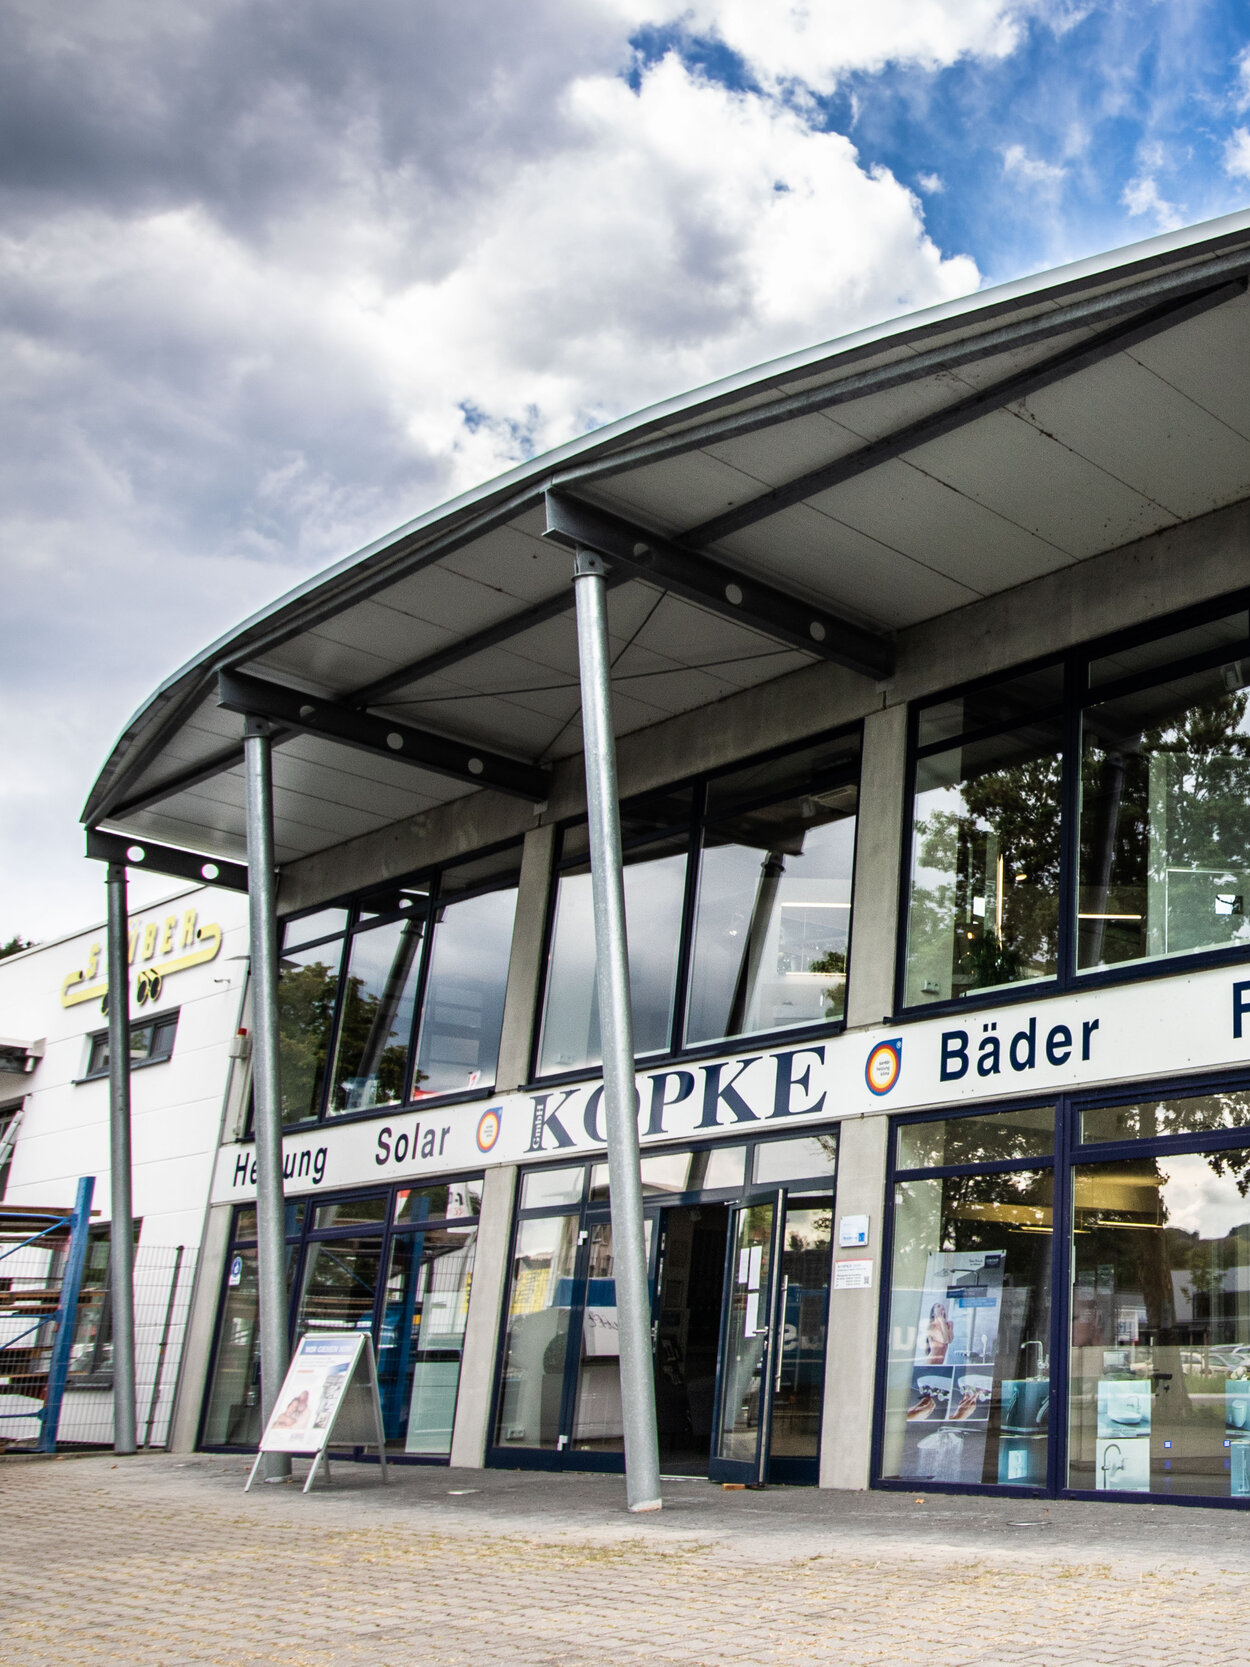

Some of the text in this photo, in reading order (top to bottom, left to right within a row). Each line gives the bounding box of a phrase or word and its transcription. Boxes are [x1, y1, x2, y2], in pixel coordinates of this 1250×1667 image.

[84, 908, 196, 979] SÜBER
[939, 1017, 1099, 1082] Bäder
[233, 1122, 451, 1188] Heung Solar
[532, 1104, 544, 1149] GmbH
